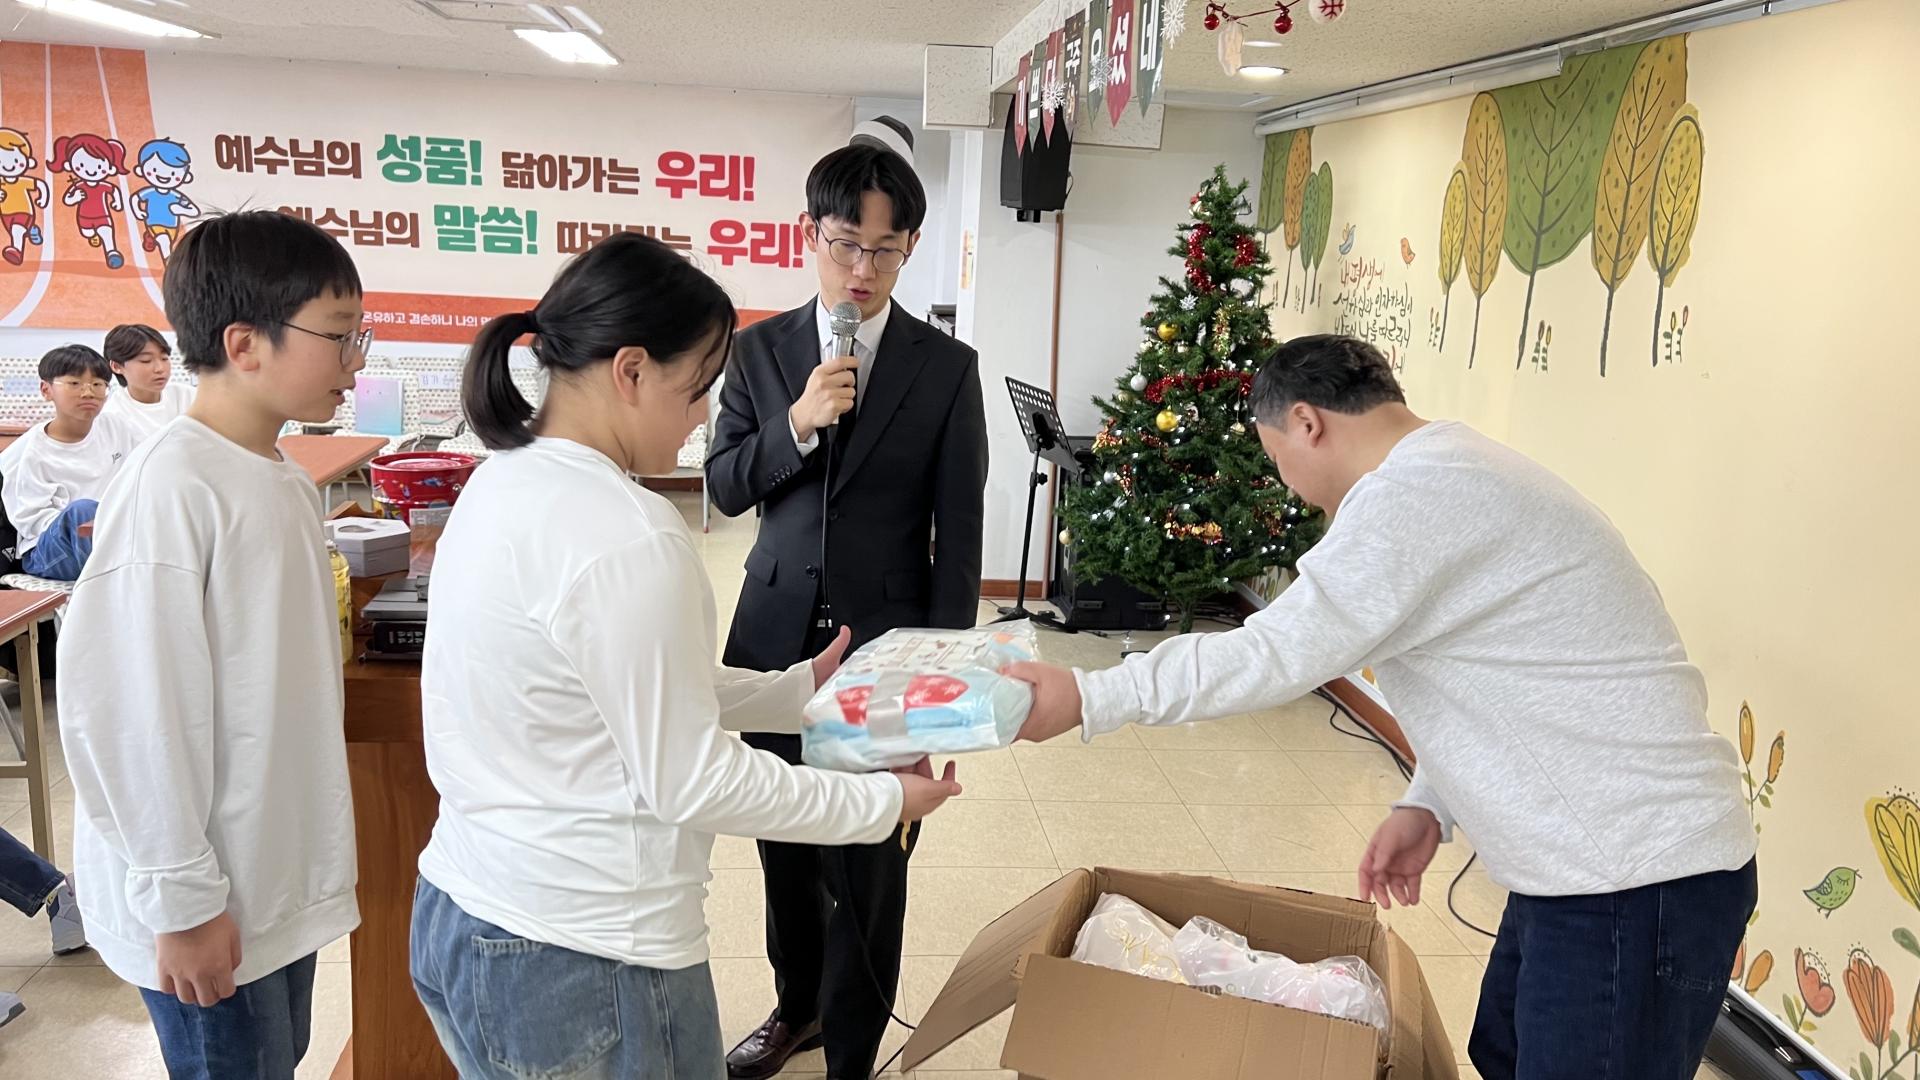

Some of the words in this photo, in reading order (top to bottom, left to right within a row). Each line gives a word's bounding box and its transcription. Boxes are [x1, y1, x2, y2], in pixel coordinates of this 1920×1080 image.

[214, 134, 362, 179] 예수님의
[377, 134, 482, 186] 성품!
[501, 151, 640, 195] 닮아가는
[656, 151, 755, 201] 우리!
[434, 204, 538, 254] 말씀!
[708, 220, 804, 268] 우리!
[409, 313, 452, 326] 겸손하니
[456, 316, 477, 327] 나의
